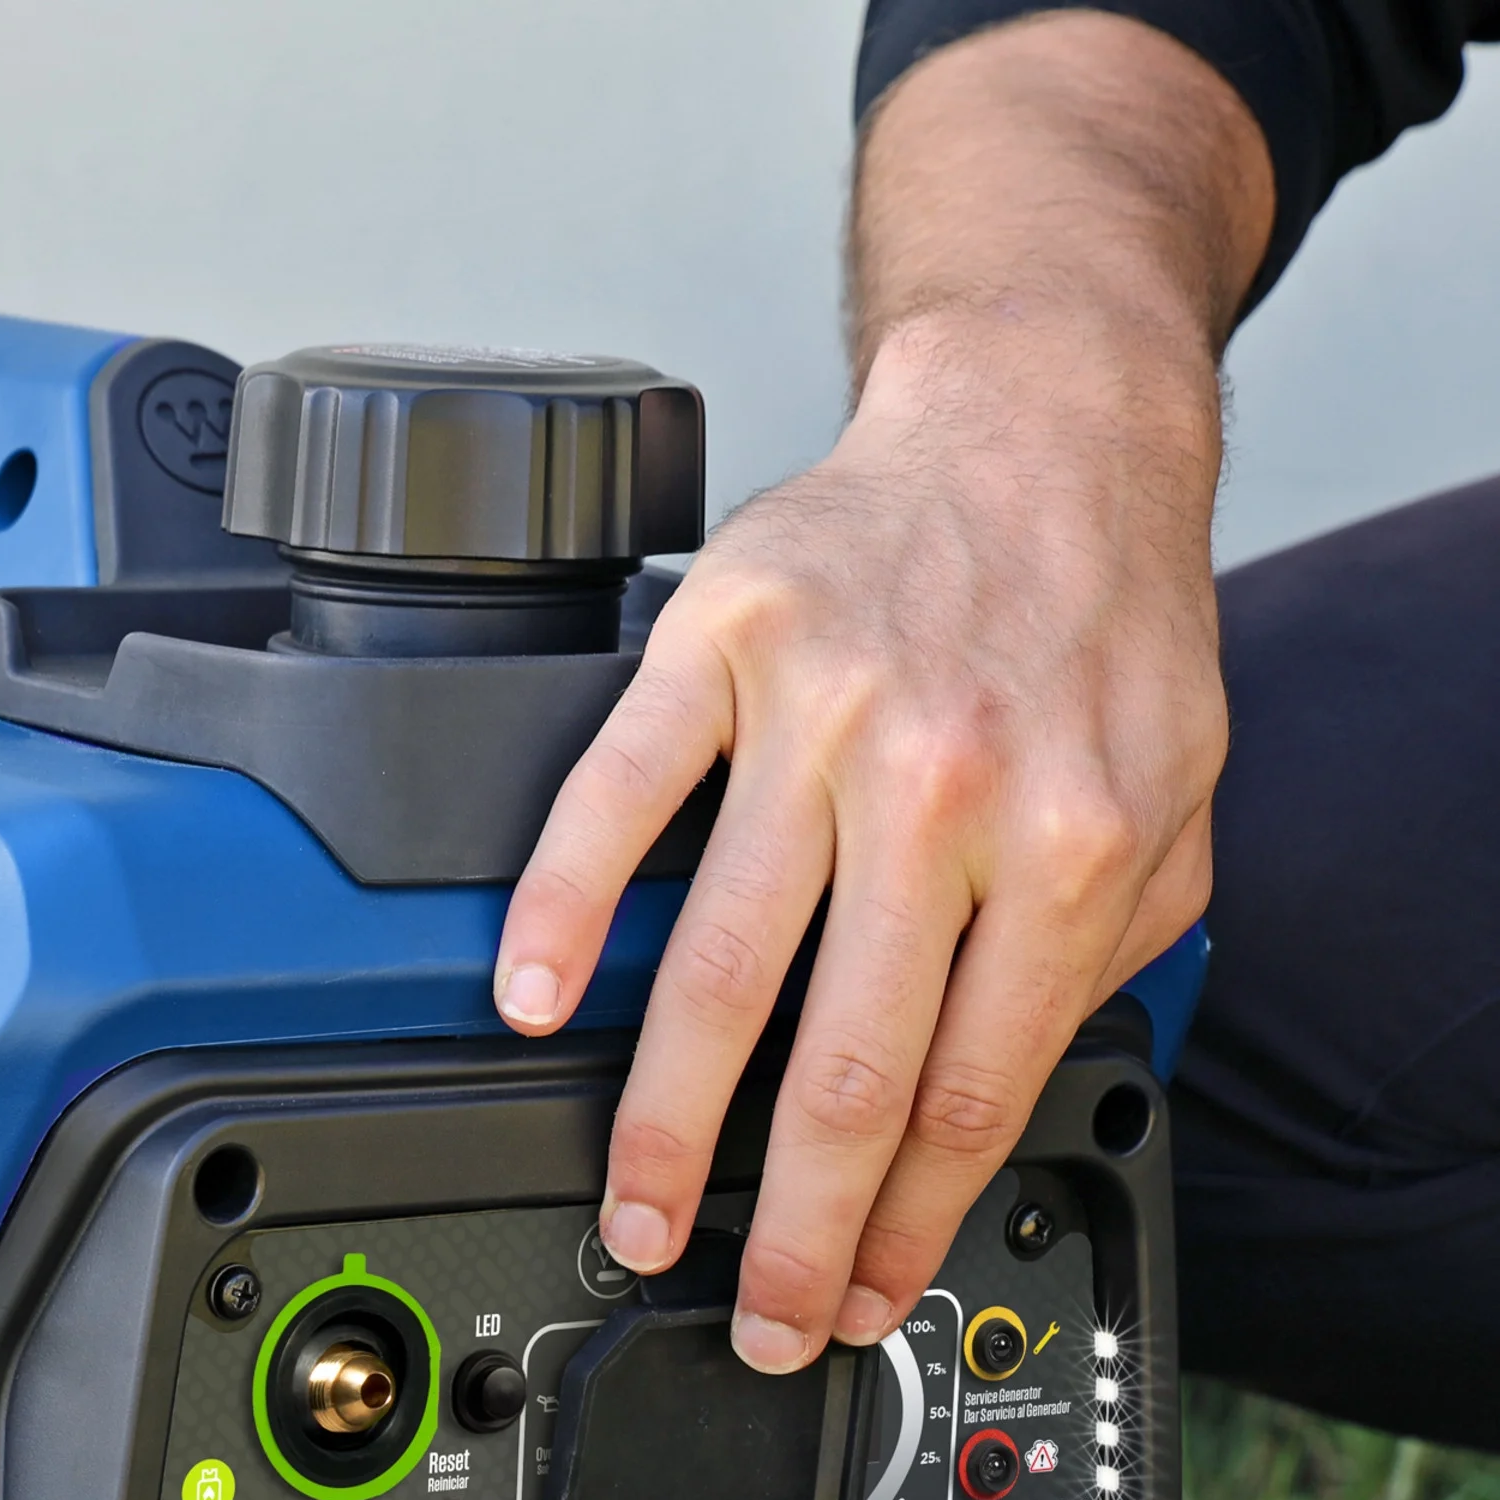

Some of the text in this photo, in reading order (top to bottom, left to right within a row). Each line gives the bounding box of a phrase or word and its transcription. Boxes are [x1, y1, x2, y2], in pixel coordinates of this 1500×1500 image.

[475, 1313, 502, 1338] LED
[906, 1319, 936, 1335] 100%
[926, 1362, 947, 1376] 75%
[965, 1386, 1043, 1407] Service Generator
[929, 1405, 952, 1420] 50%
[964, 1400, 1071, 1424] Dar Servicio al Generador
[429, 1449, 471, 1474] Reset
[920, 1451, 942, 1465] 25%
[427, 1474, 470, 1493] Reiniciar
